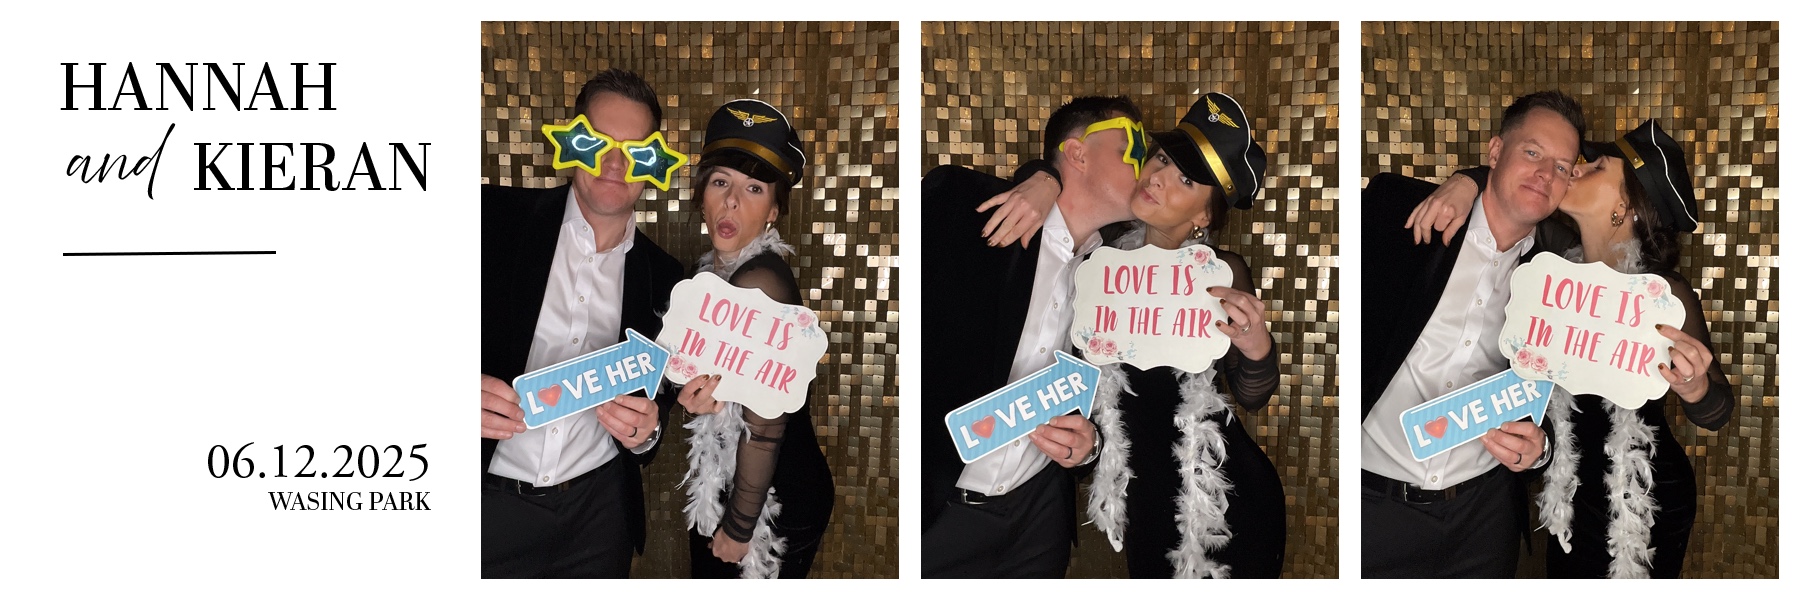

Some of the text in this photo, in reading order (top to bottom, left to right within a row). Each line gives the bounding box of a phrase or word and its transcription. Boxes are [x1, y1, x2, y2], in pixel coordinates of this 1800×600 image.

[1103, 264, 1197, 296] LOVE IS
[1541, 274, 1645, 328] LOVE IS
[698, 293, 795, 352] LOVE IS
[1128, 306, 1164, 336] THE
[1171, 307, 1212, 339] AIR
[605, 352, 657, 387] HER
[714, 340, 754, 376] THE
[754, 359, 798, 394] AIR
[1562, 325, 1605, 363] THE
[1609, 339, 1657, 378] AIR
[1036, 371, 1089, 412] HER
[1490, 380, 1542, 416] HER
